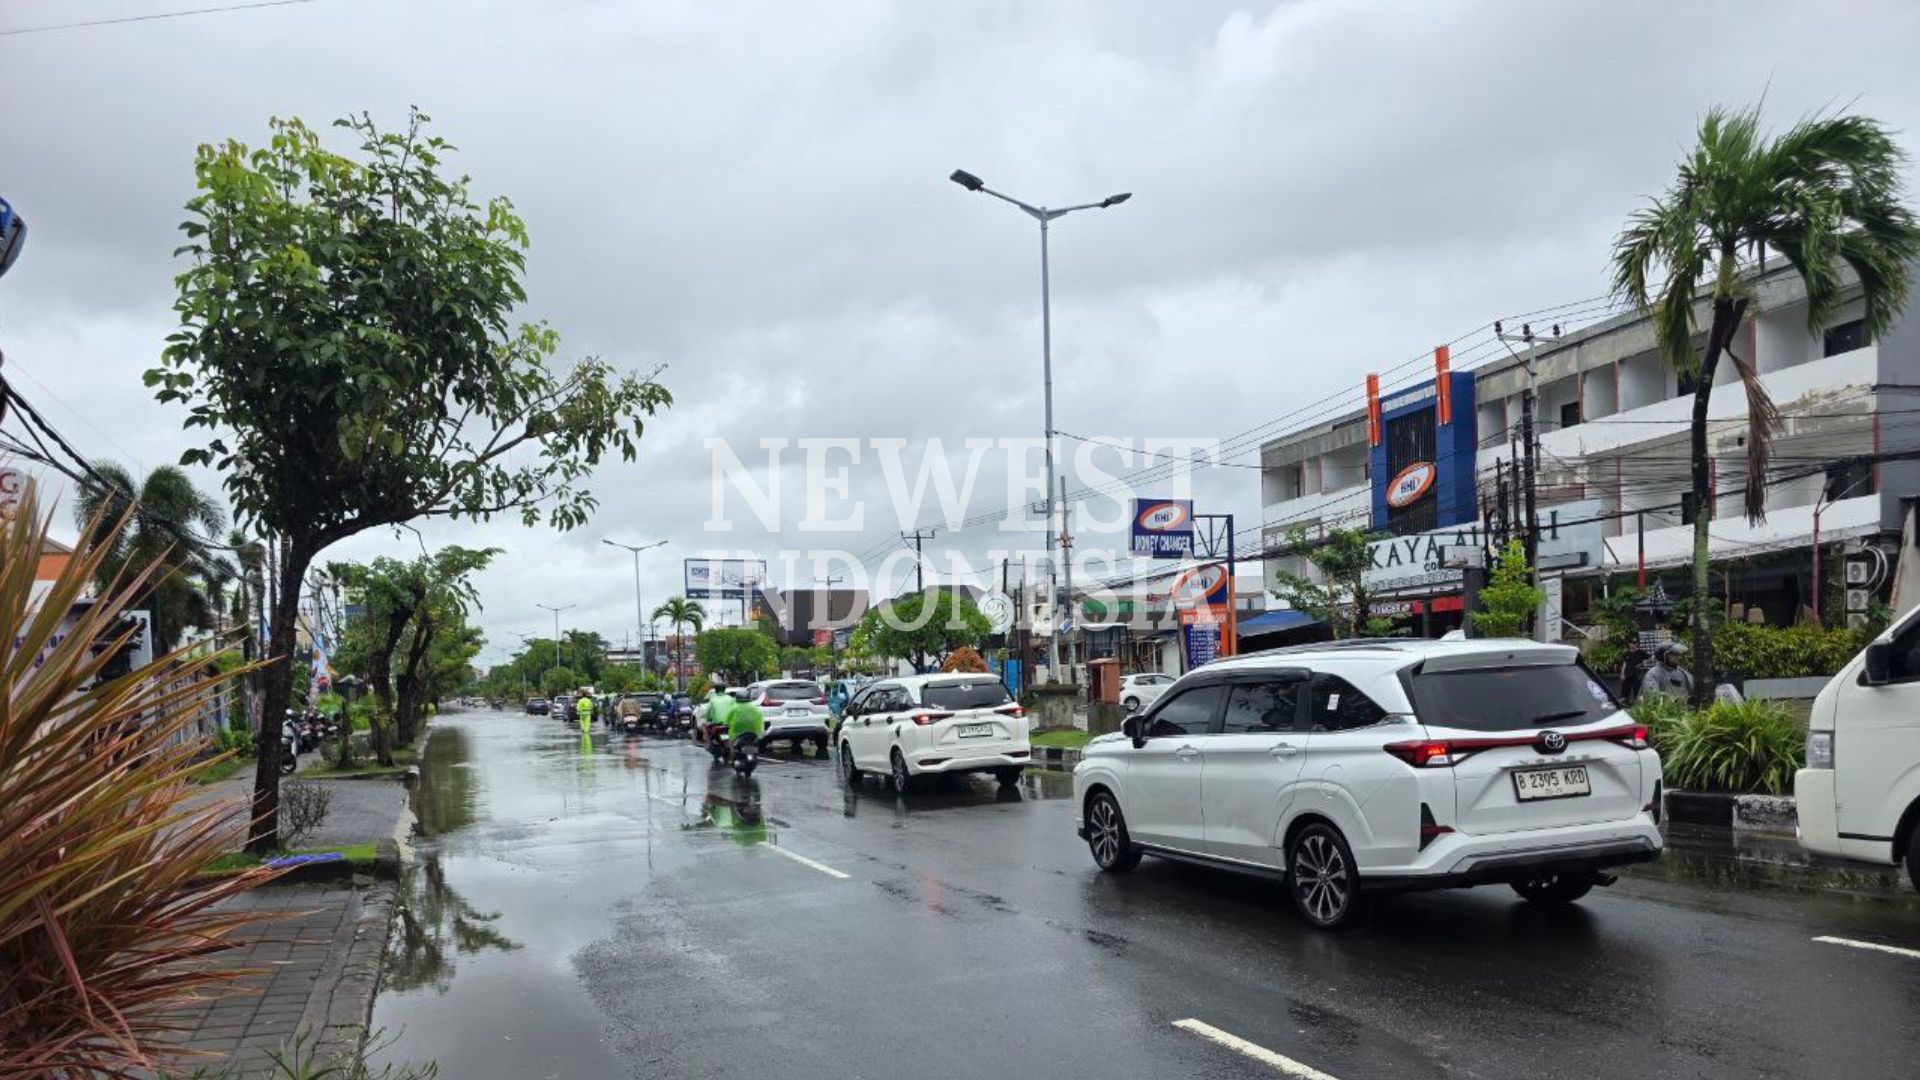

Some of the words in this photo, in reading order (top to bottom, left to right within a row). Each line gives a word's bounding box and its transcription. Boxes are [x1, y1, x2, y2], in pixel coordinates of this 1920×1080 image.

[1135, 535, 1159, 551] MONEY
[1160, 535, 1191, 552] CHANGER
[1367, 533, 1440, 569] KAYA
[1519, 775, 1526, 789] B
[1529, 772, 1560, 788] 2395
